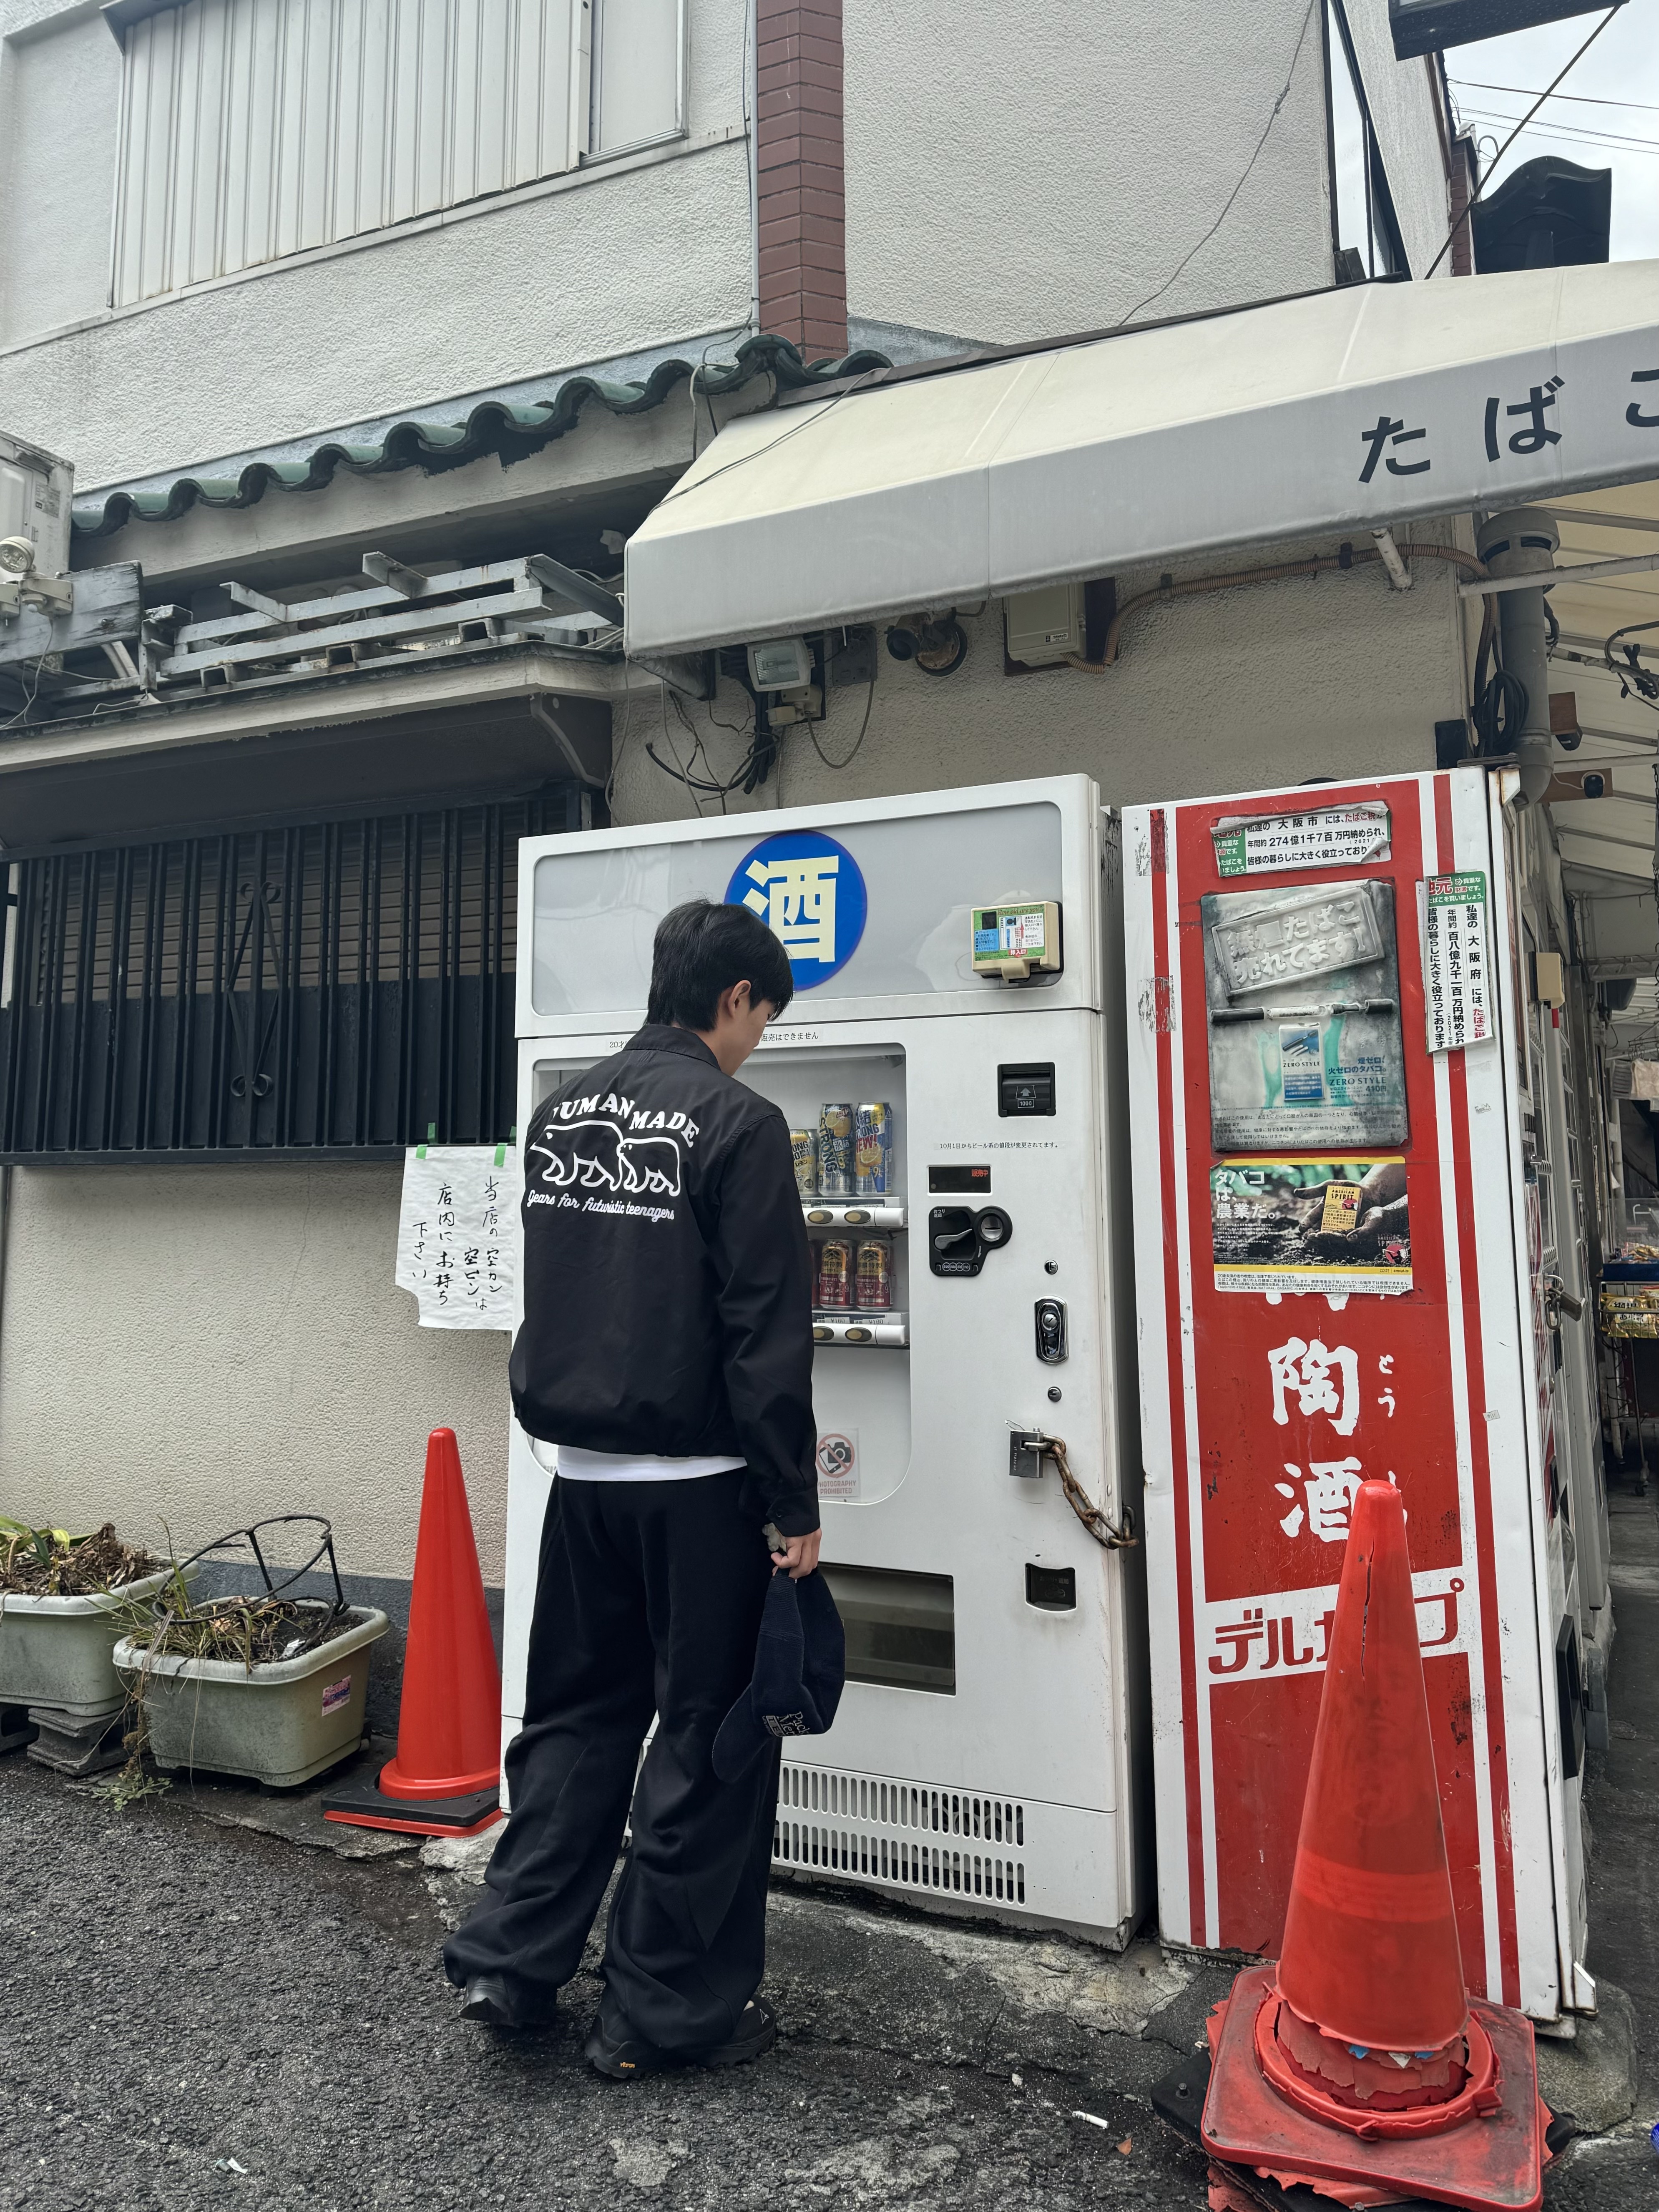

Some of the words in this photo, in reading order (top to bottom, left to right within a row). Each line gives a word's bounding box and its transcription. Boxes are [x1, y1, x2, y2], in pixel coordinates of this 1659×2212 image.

[1278, 816, 1318, 829] 大阪市
[742, 855, 839, 963] 酒
[1448, 909, 1457, 928] 年間約
[1466, 905, 1478, 928] 私達の
[1468, 935, 1481, 980] 大阪府
[629, 1111, 699, 1148] MADE
[819, 1117, 838, 1173] STRONG
[1215, 1169, 1264, 1185] タバコ
[527, 1189, 555, 1207] Gears
[558, 1193, 580, 1208] for
[626, 1201, 674, 1222] teenagers
[1215, 1186, 1237, 1201] は、
[1217, 1203, 1275, 1219] 農業だ。
[1208, 1578, 1465, 1674] デルプ
